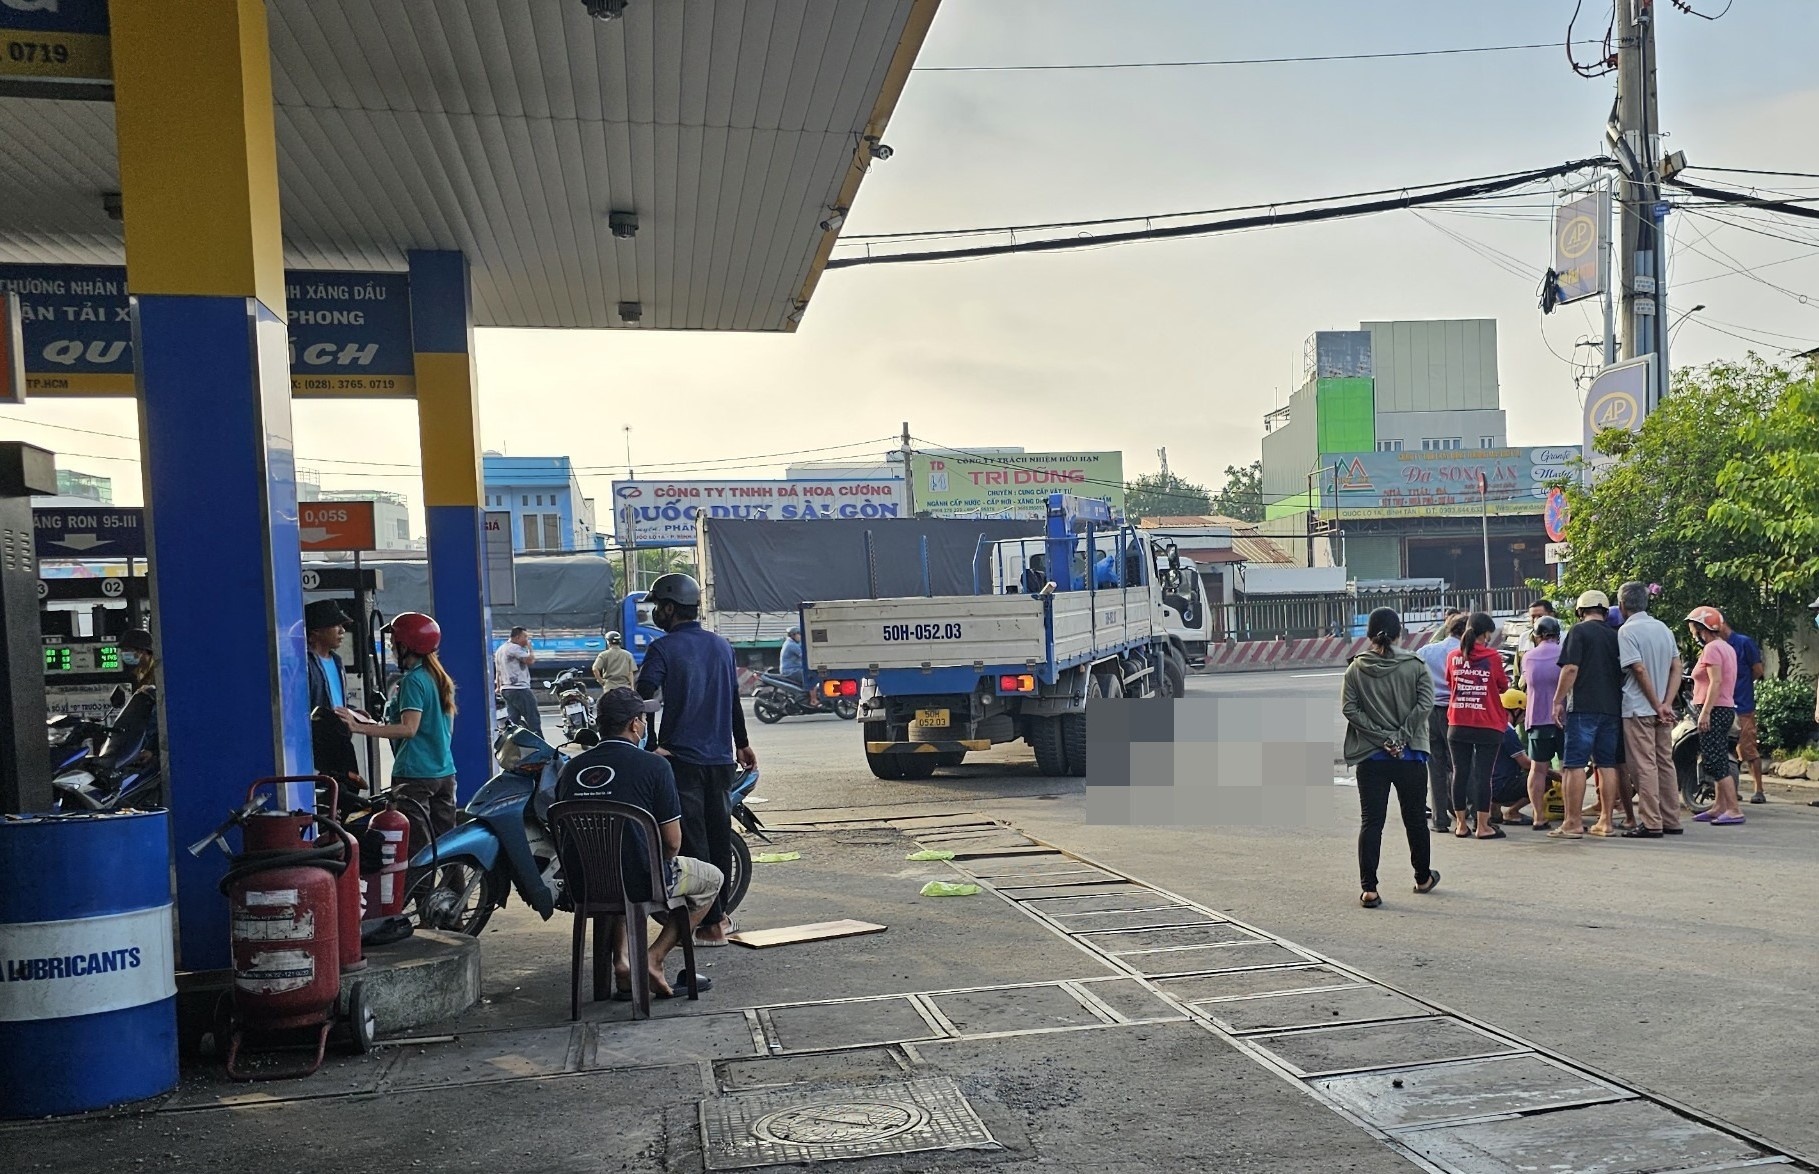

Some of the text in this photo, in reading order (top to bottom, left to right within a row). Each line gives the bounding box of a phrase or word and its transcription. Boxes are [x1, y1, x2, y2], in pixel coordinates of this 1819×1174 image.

[9, 41, 69, 63] 0719
[70, 278, 118, 296] NHÂN
[307, 281, 349, 300] XĂNG
[354, 280, 386, 300] DẦU
[21, 301, 55, 323] ẬN
[62, 301, 106, 321] TẢI
[288, 310, 365, 325] PHONG
[42, 340, 134, 365] QU
[26, 379, 69, 389] TP.HCM
[369, 380, 395, 390] 0719
[1013, 465, 1085, 485] DŨNG
[654, 484, 892, 498] CÔNG TY TNHH ĐÁ HOA CƯƠNG
[839, 498, 899, 520] GÒN
[68, 515, 98, 529] RON
[103, 514, 138, 529] 95-III
[104, 580, 121, 593] 02
[302, 574, 317, 585] 01
[883, 623, 962, 641] 50H-052.03
[1463, 660, 1470, 669] A
[8, 947, 141, 982] LUBRICANTS
